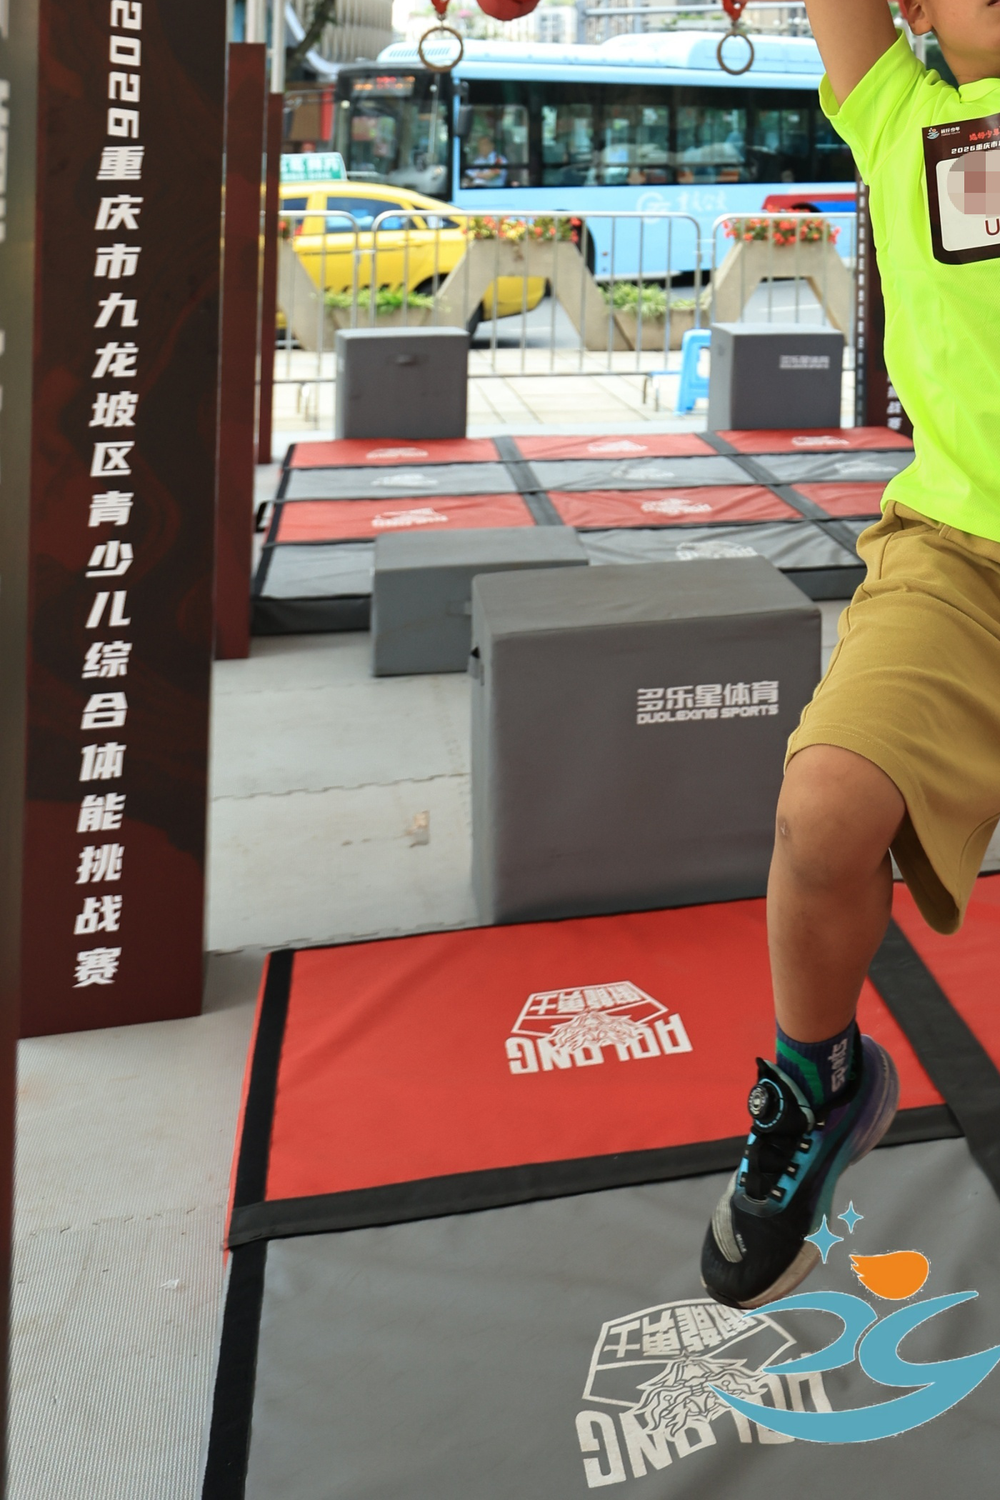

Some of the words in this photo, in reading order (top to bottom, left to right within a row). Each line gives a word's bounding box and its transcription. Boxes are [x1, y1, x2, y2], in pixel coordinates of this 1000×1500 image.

[72, 0, 145, 988] 2026重庆市九龙坡区青少儿综合体能挑战赛
[637, 680, 779, 712] 多乐星体育
[637, 708, 719, 725] DUOLEXING
[720, 704, 779, 719] SPORTS
[505, 1013, 694, 1075] AOLONG
